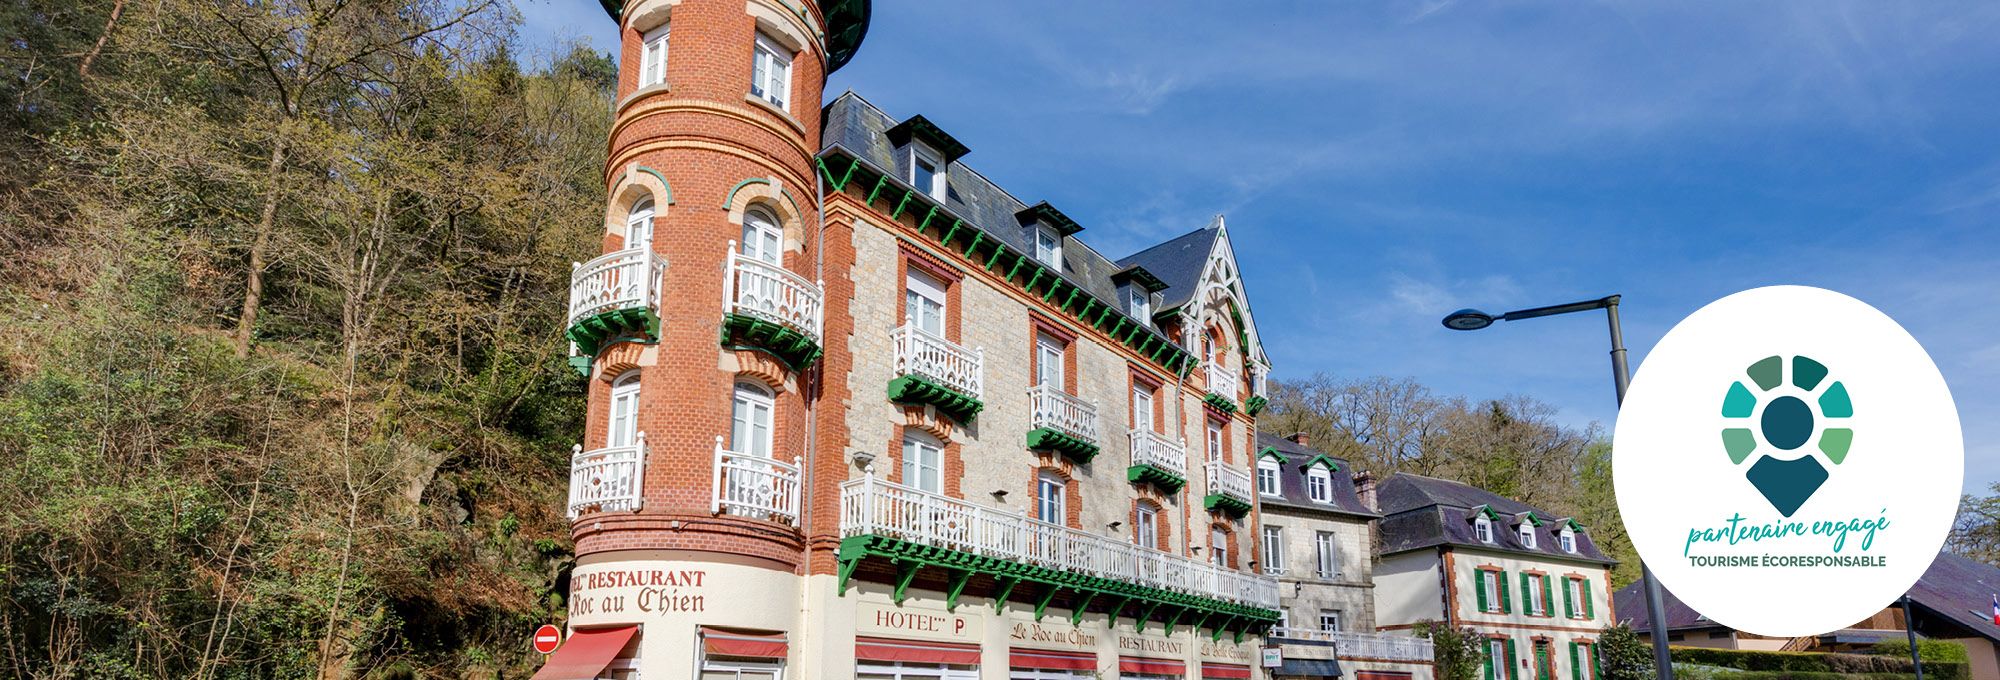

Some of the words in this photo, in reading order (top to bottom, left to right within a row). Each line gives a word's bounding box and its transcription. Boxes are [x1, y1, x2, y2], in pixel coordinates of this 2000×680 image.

[588, 570, 706, 590] RESTAURANT
[602, 595, 625, 614] au
[637, 586, 705, 617] Chien
[876, 610, 939, 632] HOTEL
[955, 618, 965, 634] P
[1011, 622, 1026, 640] Le
[1031, 623, 1052, 642] Roc
[1054, 631, 1066, 643] au
[1068, 627, 1095, 649] Chien
[1119, 636, 1183, 654] RESTAURANT
